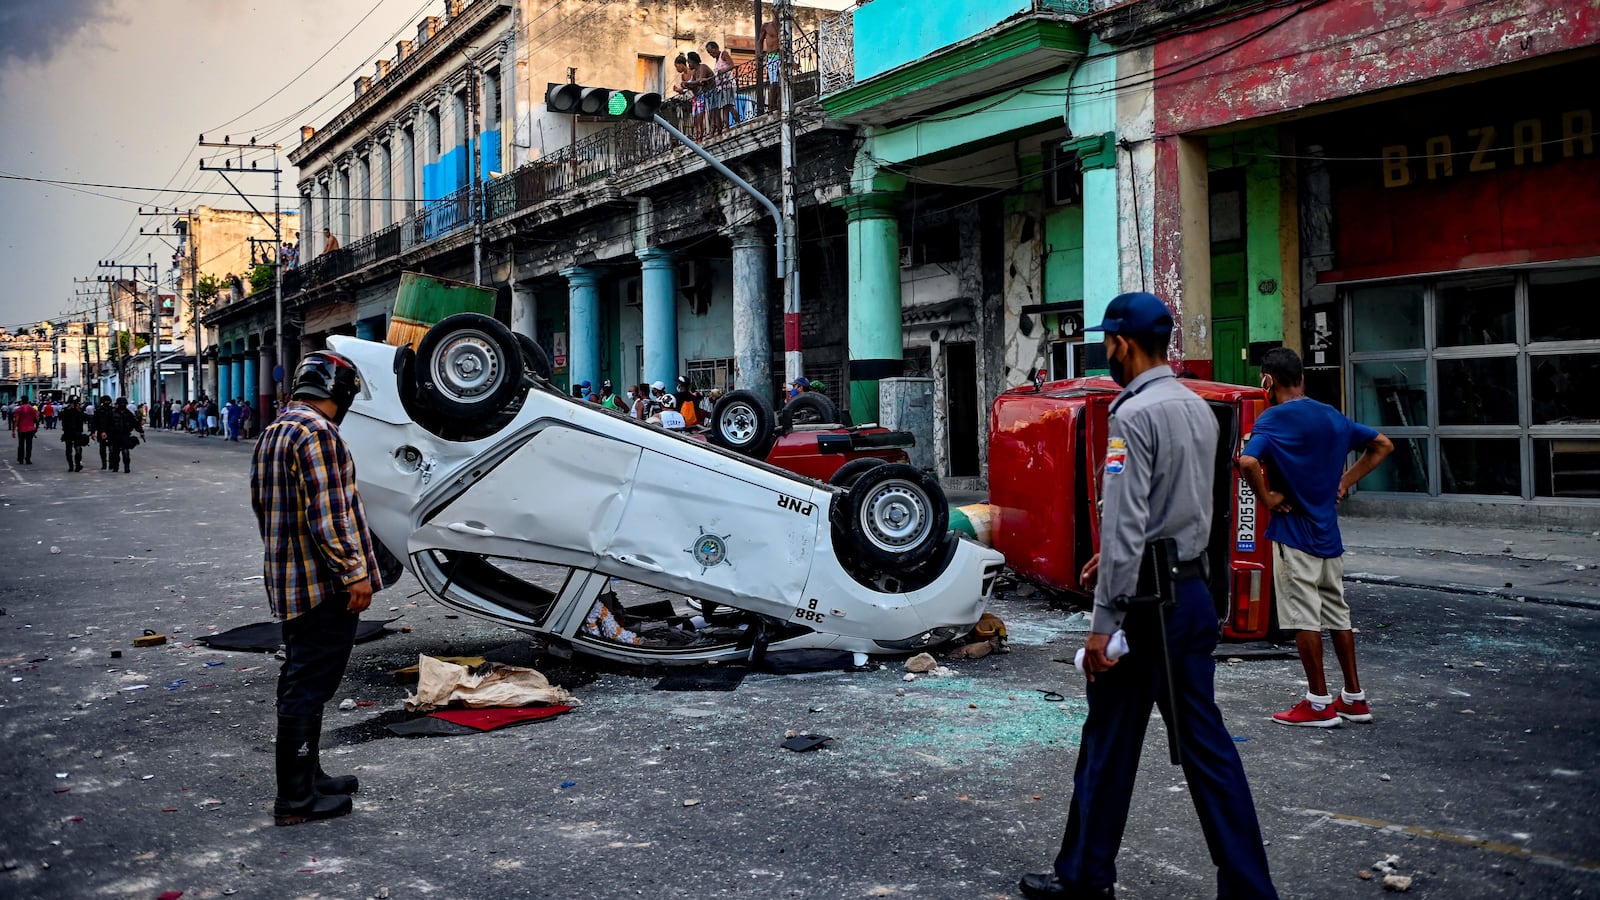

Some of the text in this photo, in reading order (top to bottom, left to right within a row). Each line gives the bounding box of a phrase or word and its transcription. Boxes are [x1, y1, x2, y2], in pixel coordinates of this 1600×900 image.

[1381, 108, 1594, 189] BAZAR
[777, 494, 813, 517] PNR
[1240, 507, 1254, 531] 205
[1240, 533, 1253, 541] B
[808, 598, 818, 610] B
[795, 607, 826, 624] 388
